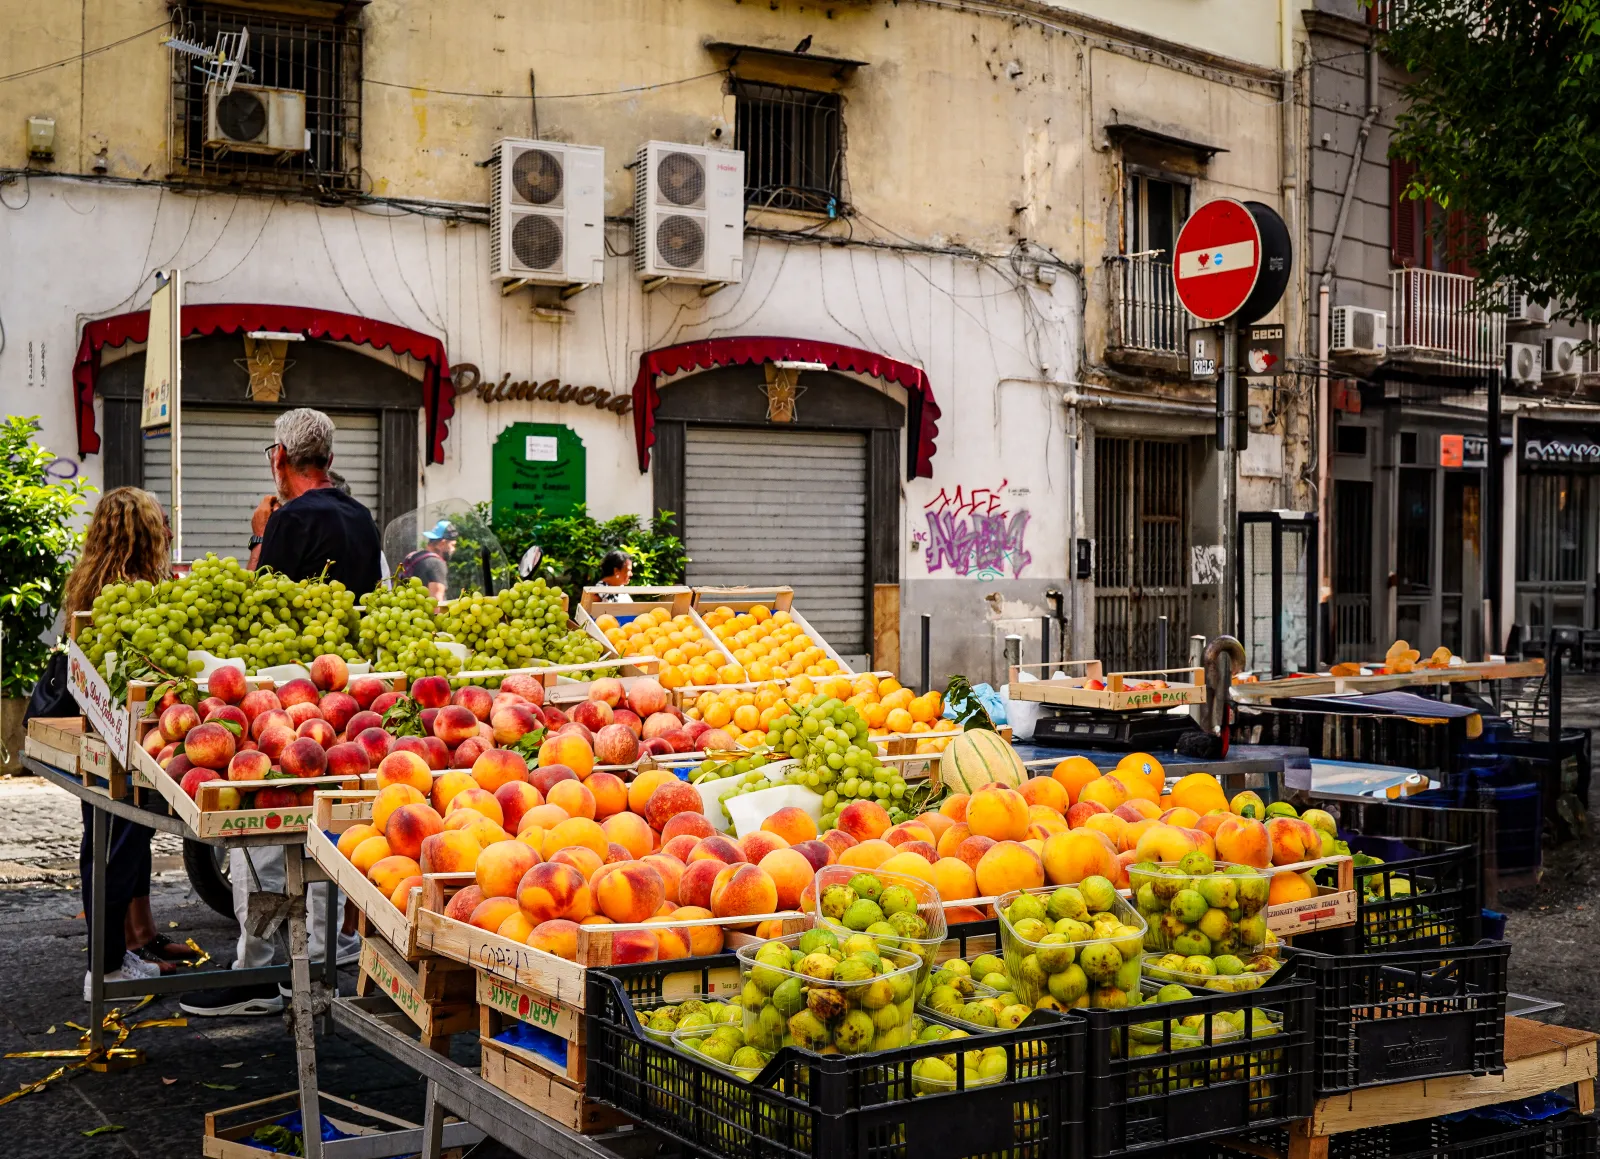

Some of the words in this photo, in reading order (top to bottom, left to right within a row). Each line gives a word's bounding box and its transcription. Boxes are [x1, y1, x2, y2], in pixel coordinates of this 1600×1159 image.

[716, 164, 737, 172] Haier
[449, 363, 633, 415] Primavera
[1126, 694, 1152, 705] AGRI
[1162, 691, 1188, 702] PACK
[221, 816, 264, 830] AGRI
[282, 813, 313, 826] PAC
[370, 958, 392, 991] PACK
[399, 985, 419, 1015] AGRI
[490, 986, 519, 1012] PACK
[528, 1000, 559, 1028] AGRI
